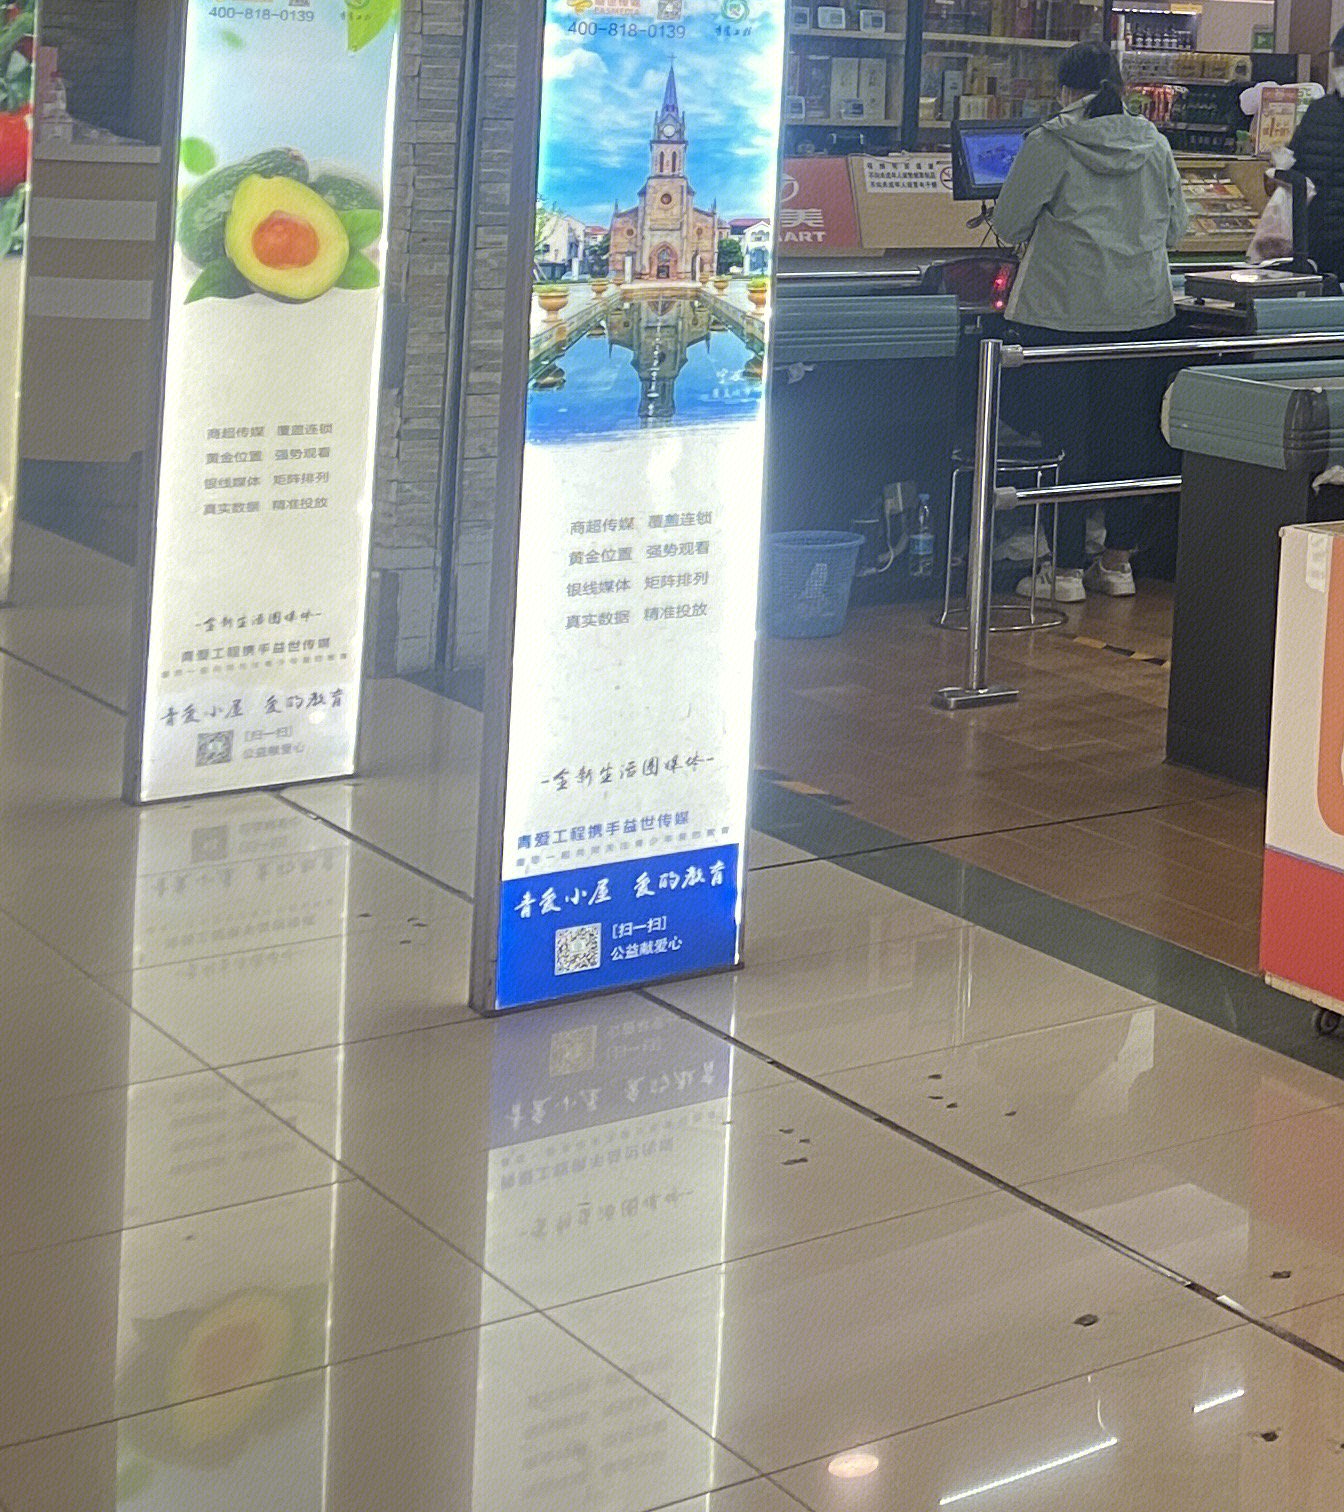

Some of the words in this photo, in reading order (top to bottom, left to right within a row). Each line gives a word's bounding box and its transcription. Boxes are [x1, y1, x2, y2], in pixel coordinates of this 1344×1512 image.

[209, 6, 315, 23] 400-818-0139
[568, 21, 686, 39] 400-818-0139
[570, 516, 635, 536] 商超传媒
[648, 510, 712, 530] 覆盖连锁
[568, 547, 632, 566] 黄金位置
[646, 540, 710, 559] 强势观看
[566, 577, 631, 598] 银线媒体
[644, 570, 709, 590] 矩阵排列
[565, 609, 630, 629] 真实数据
[643, 602, 707, 622] 精准投放
[517, 810, 689, 850] 青爱工程携手益世传媒
[514, 880, 613, 919] 青爱小屋
[633, 860, 725, 898] 爱的教育
[610, 936, 683, 961] 公益献爱心
